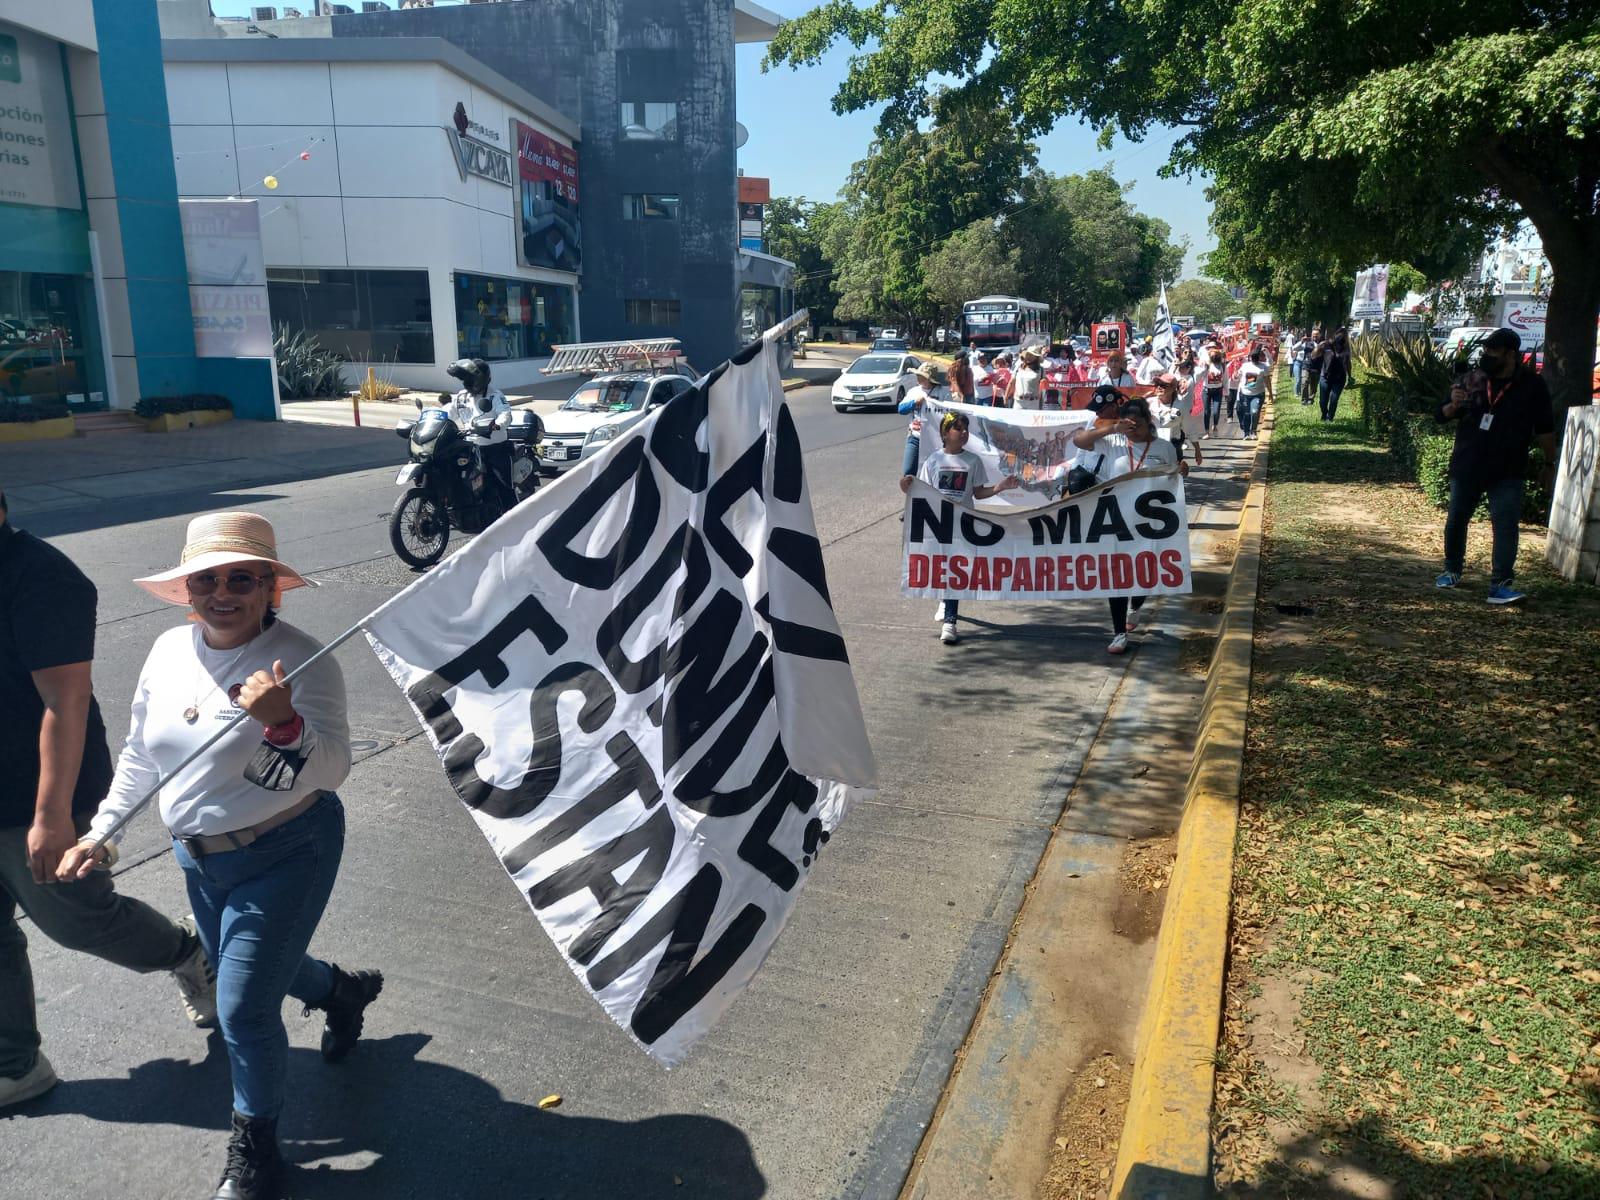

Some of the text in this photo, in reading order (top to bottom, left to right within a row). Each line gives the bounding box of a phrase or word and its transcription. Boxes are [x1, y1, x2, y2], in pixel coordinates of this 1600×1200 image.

[910, 487, 1180, 547] NO MÁS
[908, 549, 1184, 592] DESAPARECIDOS
